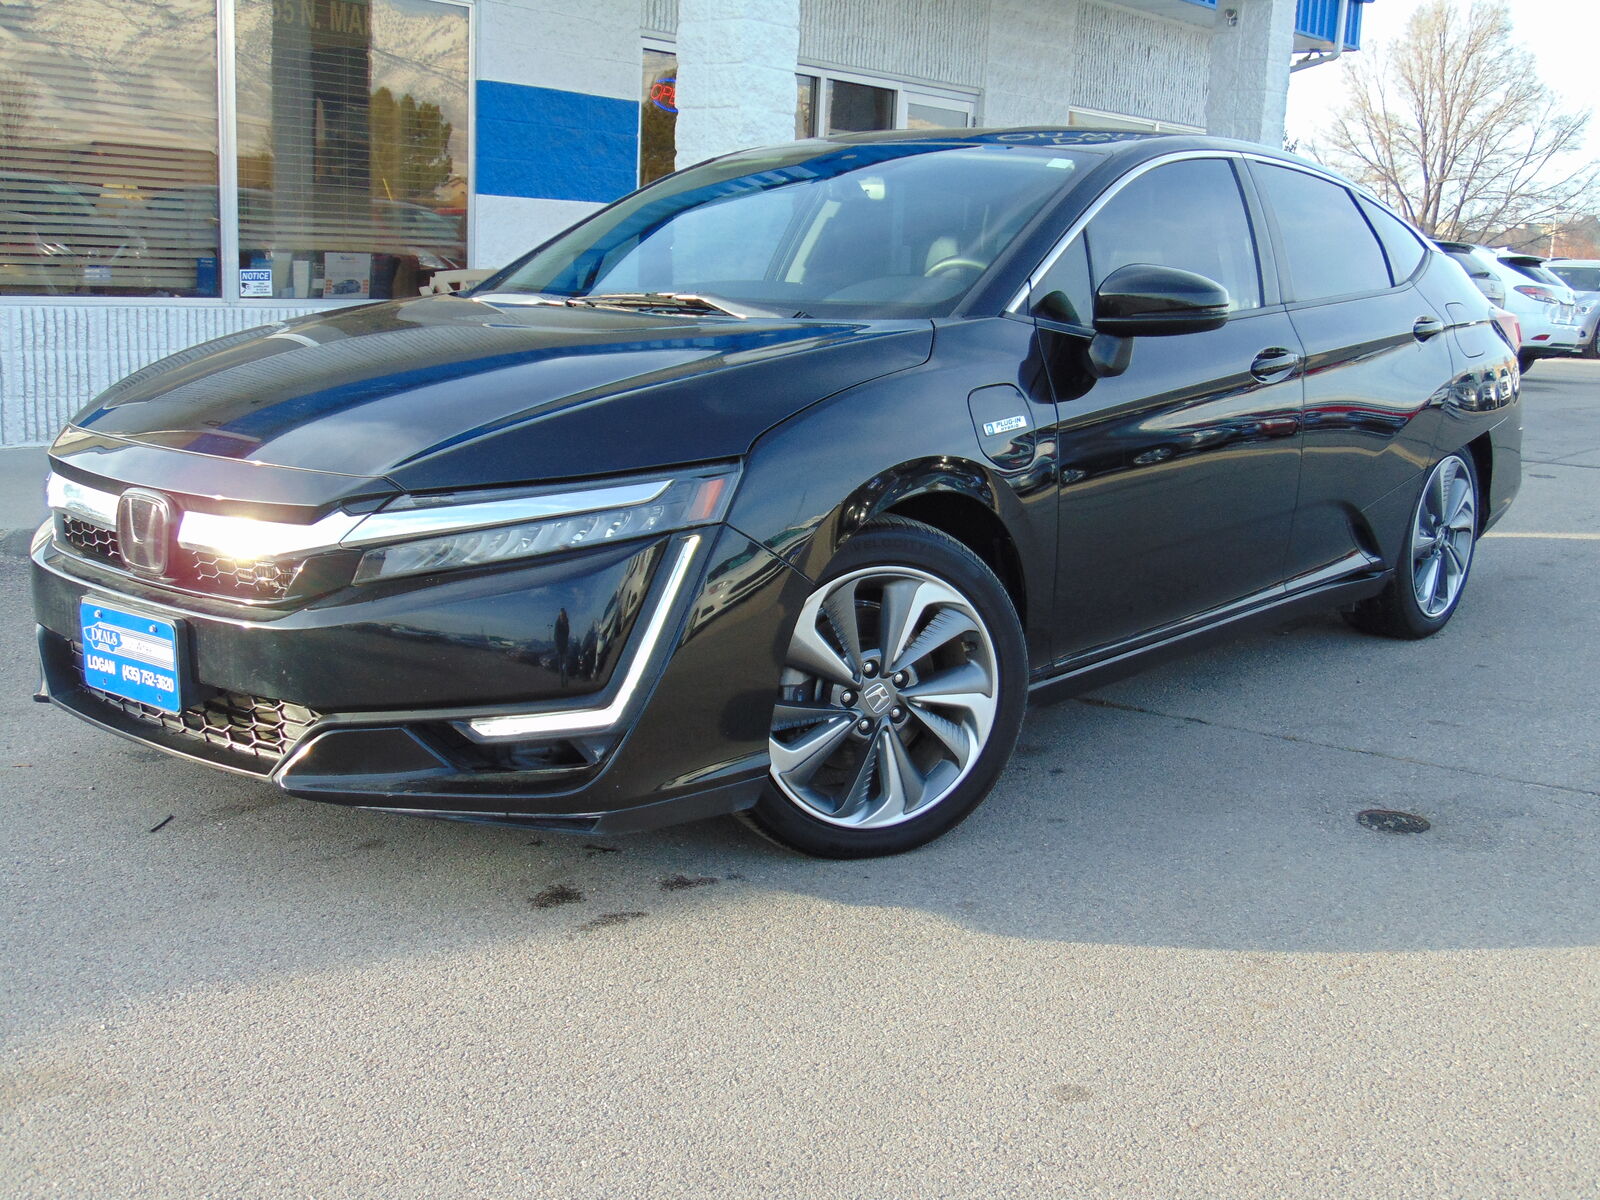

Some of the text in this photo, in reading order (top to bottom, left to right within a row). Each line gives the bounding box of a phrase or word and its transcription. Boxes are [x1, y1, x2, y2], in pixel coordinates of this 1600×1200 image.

[241, 272, 269, 280] NOTICE
[996, 417, 1021, 429] PLUG-IN
[87, 654, 116, 675] LOGAN
